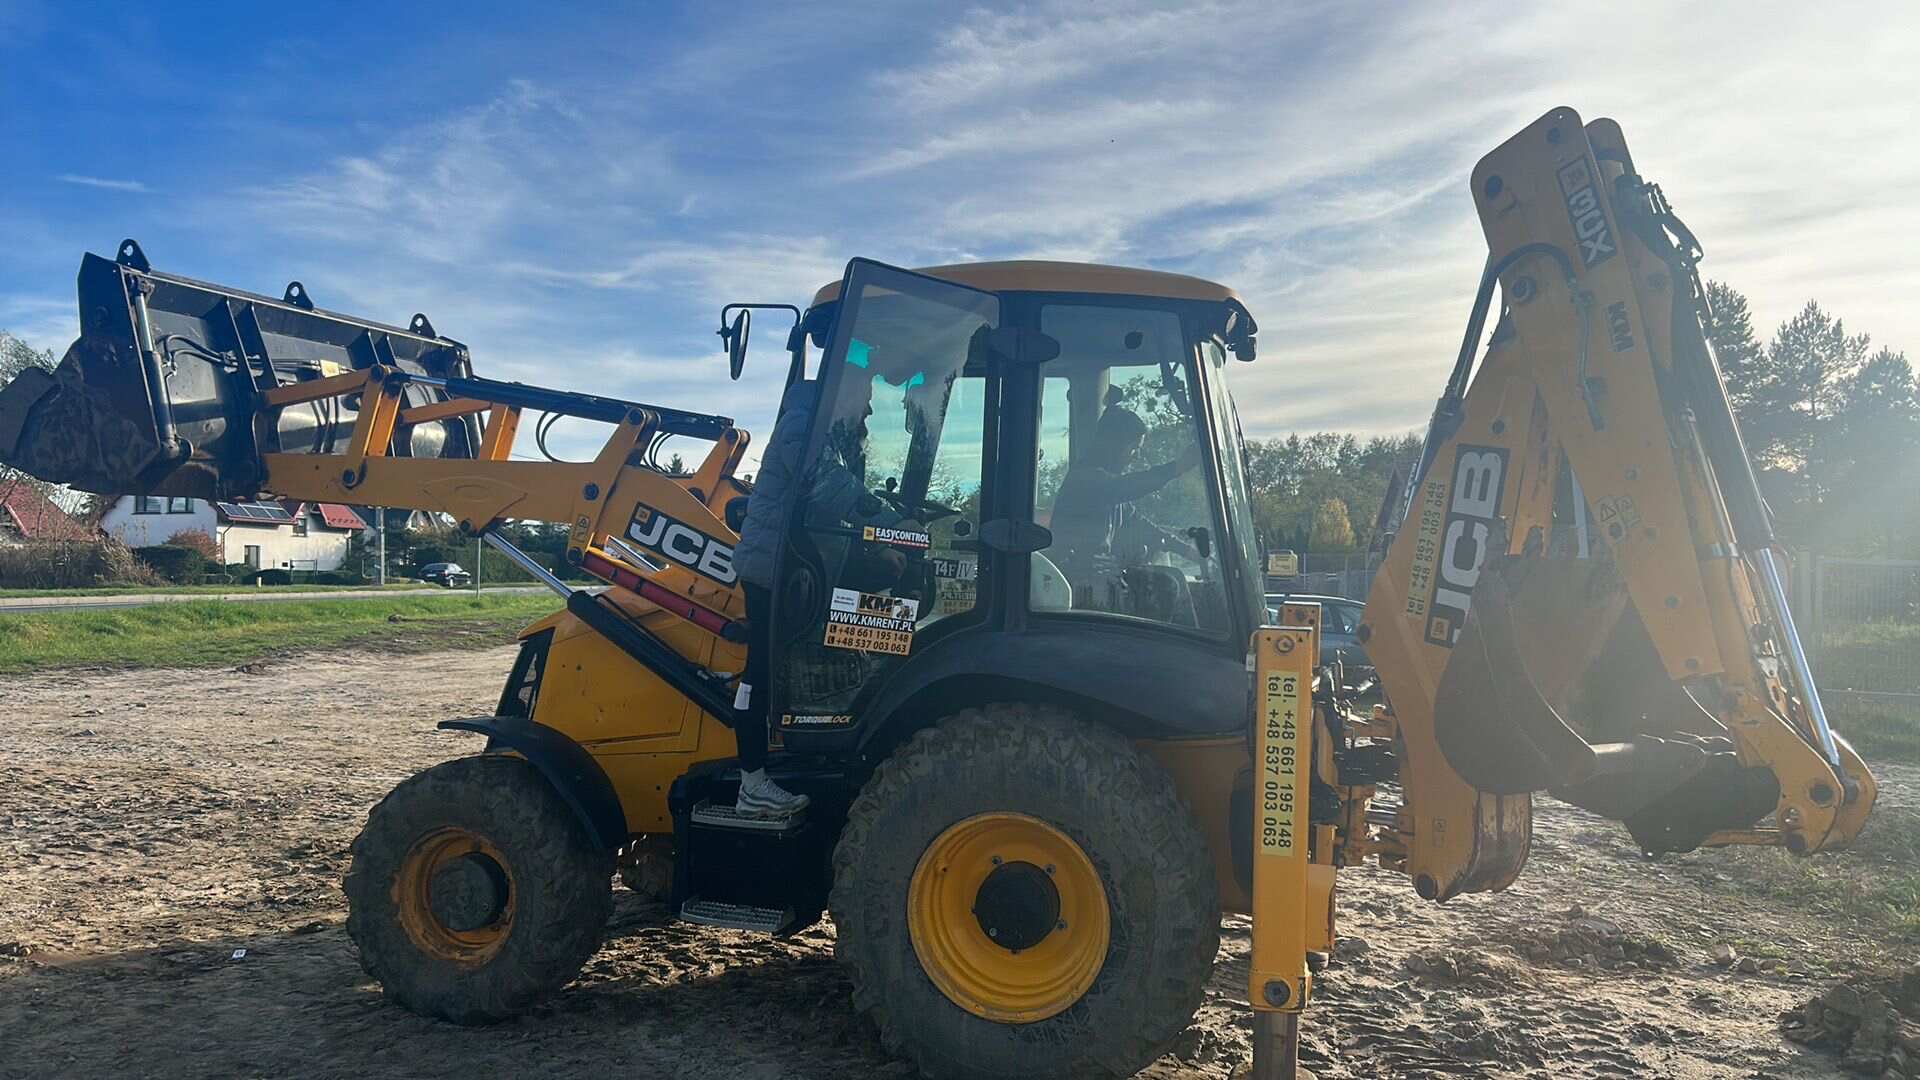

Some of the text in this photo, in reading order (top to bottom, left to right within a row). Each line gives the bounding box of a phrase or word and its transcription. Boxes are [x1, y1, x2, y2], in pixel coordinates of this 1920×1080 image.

[1568, 187, 1614, 263] 3CX
[876, 527, 930, 543] EASYCONTROL
[629, 515, 737, 583] JCB
[860, 594, 895, 613] KM
[830, 610, 913, 632] WWW.KMRENT.PL
[836, 636, 907, 653] +48 537 003 063
[839, 626, 910, 643] +48 661 195 148
[1263, 676, 1281, 847] tel. +48 537 003 063
[1278, 677, 1297, 848] tel. +48 661 195 148
